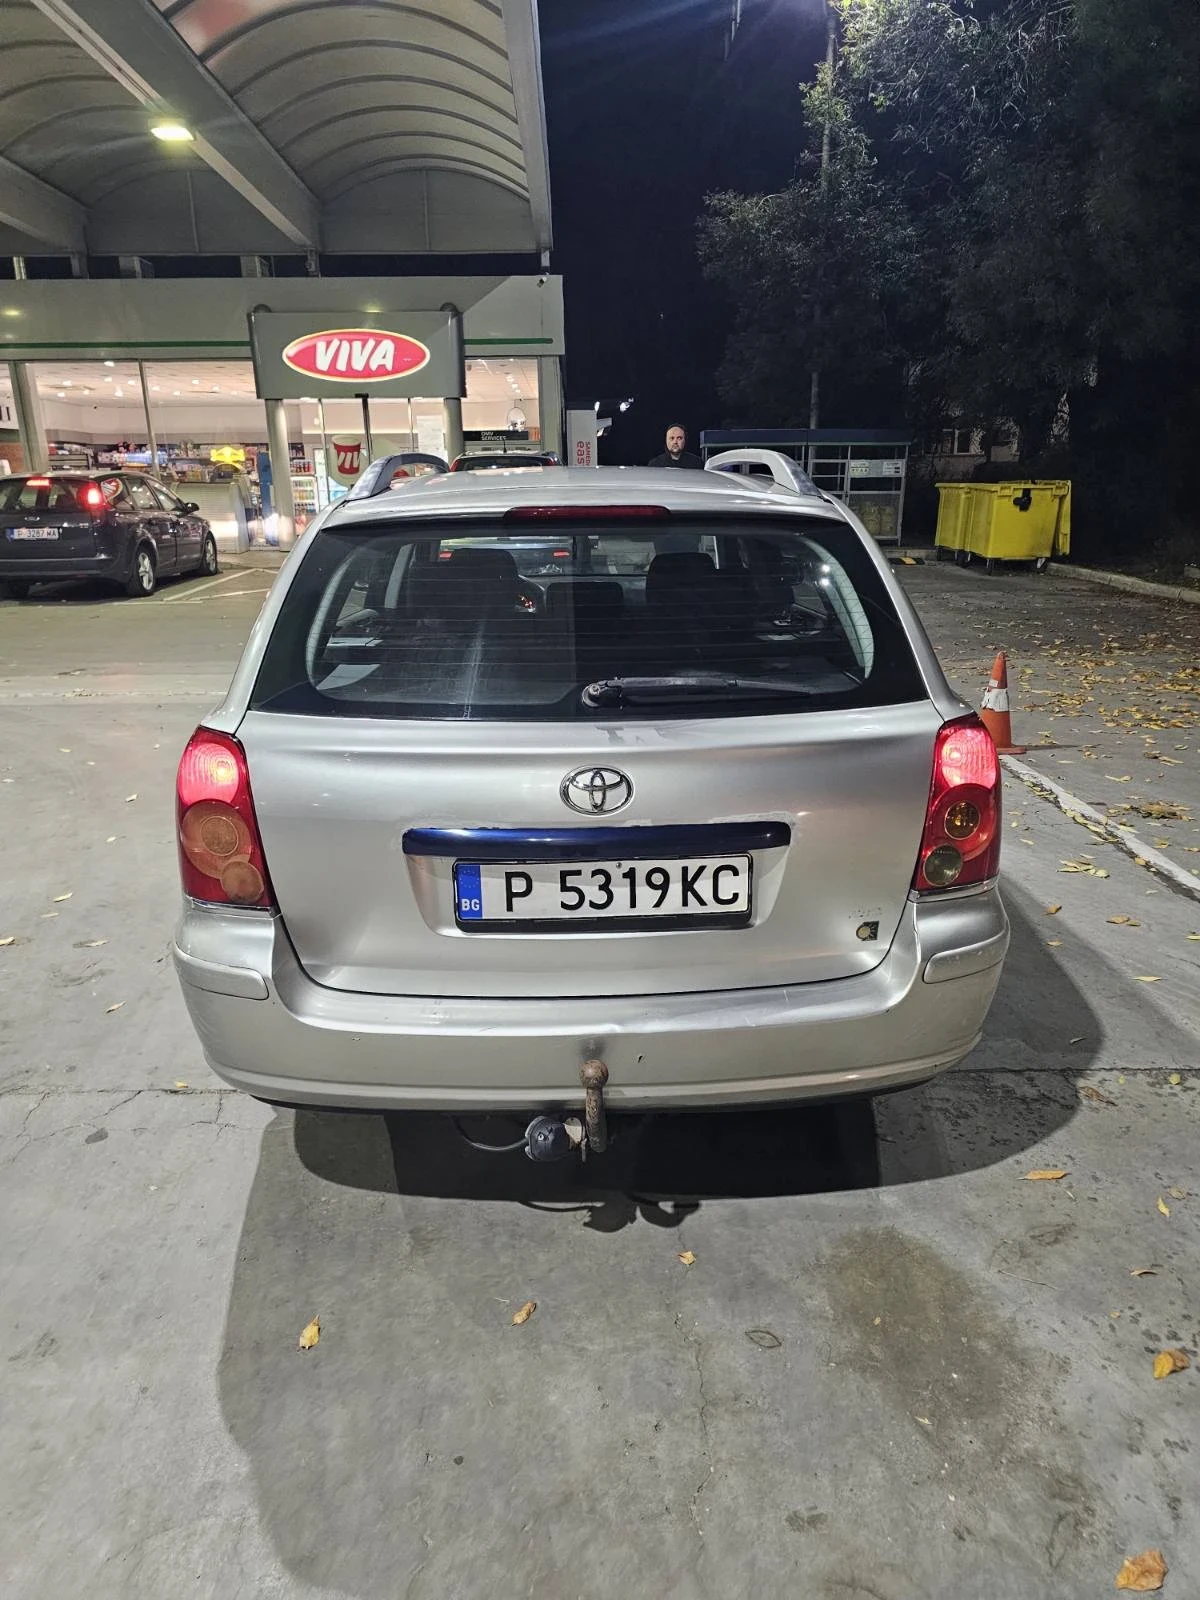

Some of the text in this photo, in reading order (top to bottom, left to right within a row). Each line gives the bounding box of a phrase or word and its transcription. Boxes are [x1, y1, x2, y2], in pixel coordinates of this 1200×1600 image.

[315, 338, 395, 371] VIVA
[461, 898, 480, 911] BG
[504, 871, 533, 912] P
